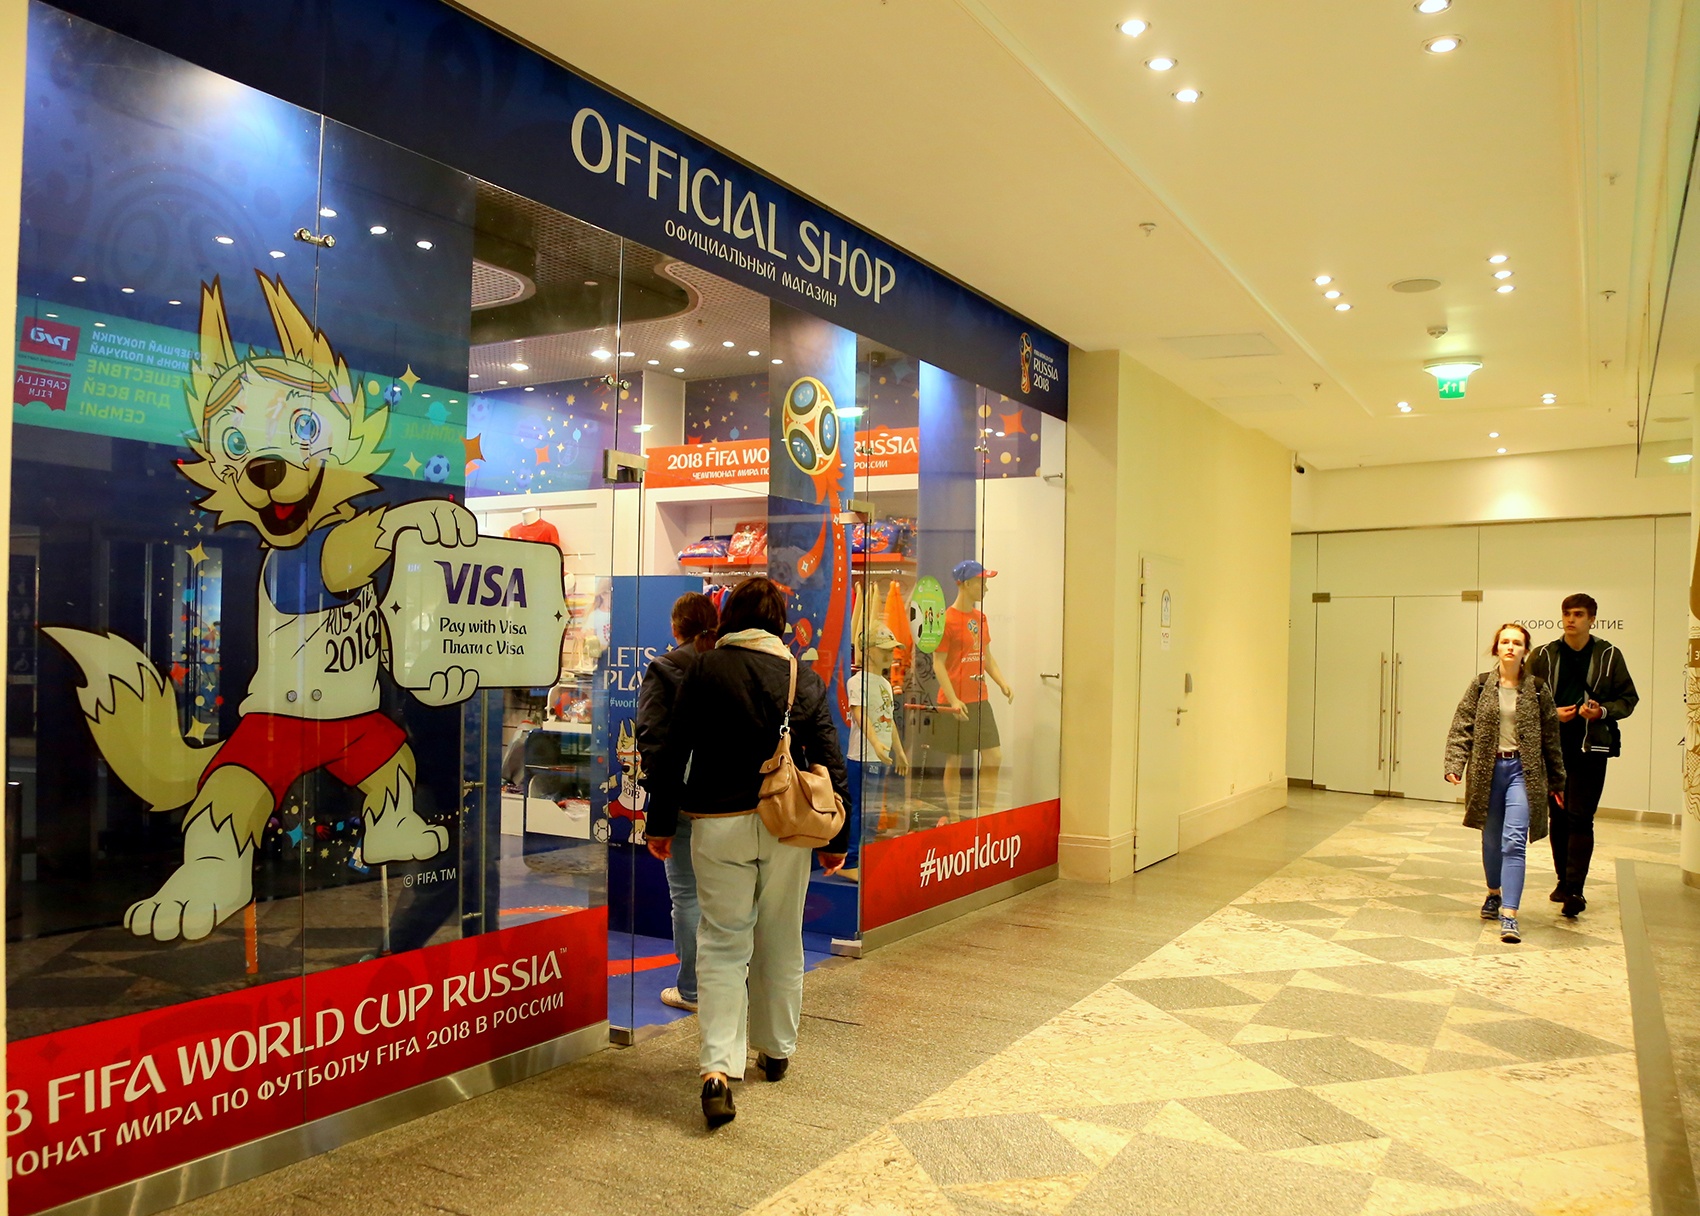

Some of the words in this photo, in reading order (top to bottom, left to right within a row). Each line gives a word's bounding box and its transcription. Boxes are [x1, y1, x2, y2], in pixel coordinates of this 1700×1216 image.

[571, 107, 787, 260] OFFICIAL
[797, 220, 896, 303] SHOP
[665, 219, 776, 281] ОФИЦИАЛЬНЫЙ
[782, 272, 837, 307] МАГАЗИН
[1033, 357, 1059, 381] RUSSIA
[1033, 373, 1050, 392] 2018
[667, 453, 702, 470] 2018
[705, 449, 739, 467] FIFA
[743, 447, 769, 465] WO
[433, 560, 527, 608] VISA
[440, 617, 465, 637] Pay
[469, 619, 496, 633] with
[499, 619, 527, 635] Visa
[324, 610, 380, 673] 2018
[443, 639, 483, 654] Плати
[486, 644, 493, 654] с
[496, 640, 525, 655] Visa
[607, 646, 657, 668] LETS
[604, 670, 644, 691] PLA
[610, 697, 639, 708] #worl
[920, 832, 1021, 888] #worldcup
[417, 871, 438, 885] FIFA
[440, 868, 456, 880] TM
[48, 1054, 167, 1125] FIFA
[177, 1008, 345, 1086] WORLD
[353, 983, 434, 1035] CUP
[116, 1101, 203, 1146] МИРА
[211, 1087, 249, 1117] ПО
[257, 1050, 370, 1100] ФУТБОЛУ
[376, 1036, 420, 1066] FIFA
[426, 1020, 471, 1050] 2018
[476, 1015, 488, 1034] В
[493, 991, 564, 1029] РОССИИ
